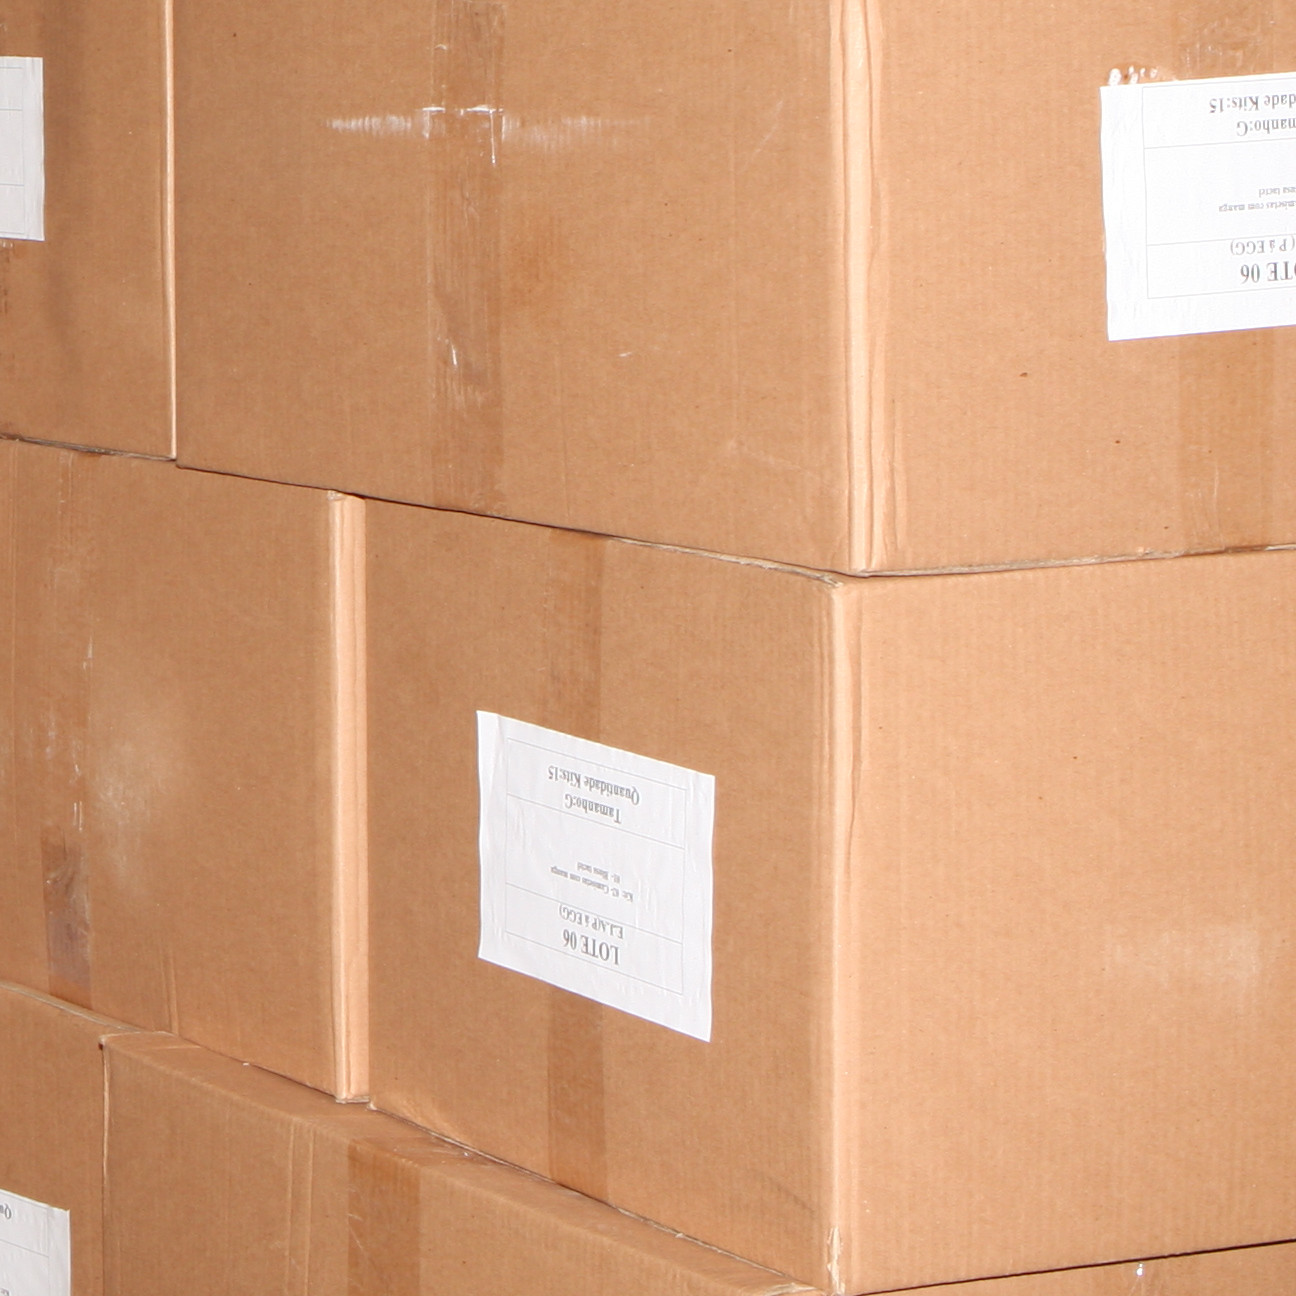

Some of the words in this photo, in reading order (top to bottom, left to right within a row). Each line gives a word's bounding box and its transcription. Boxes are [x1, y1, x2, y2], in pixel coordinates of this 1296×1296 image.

[1209, 95, 1259, 113] Kits:15
[1236, 117, 1296, 137] manho:G
[1240, 263, 1260, 284] 06
[548, 765, 581, 788] Kits:15
[583, 776, 640, 806] Quantidade
[564, 793, 622, 824] Tamanho:G
[563, 929, 577, 951] 06
[580, 935, 619, 965] LOTE
